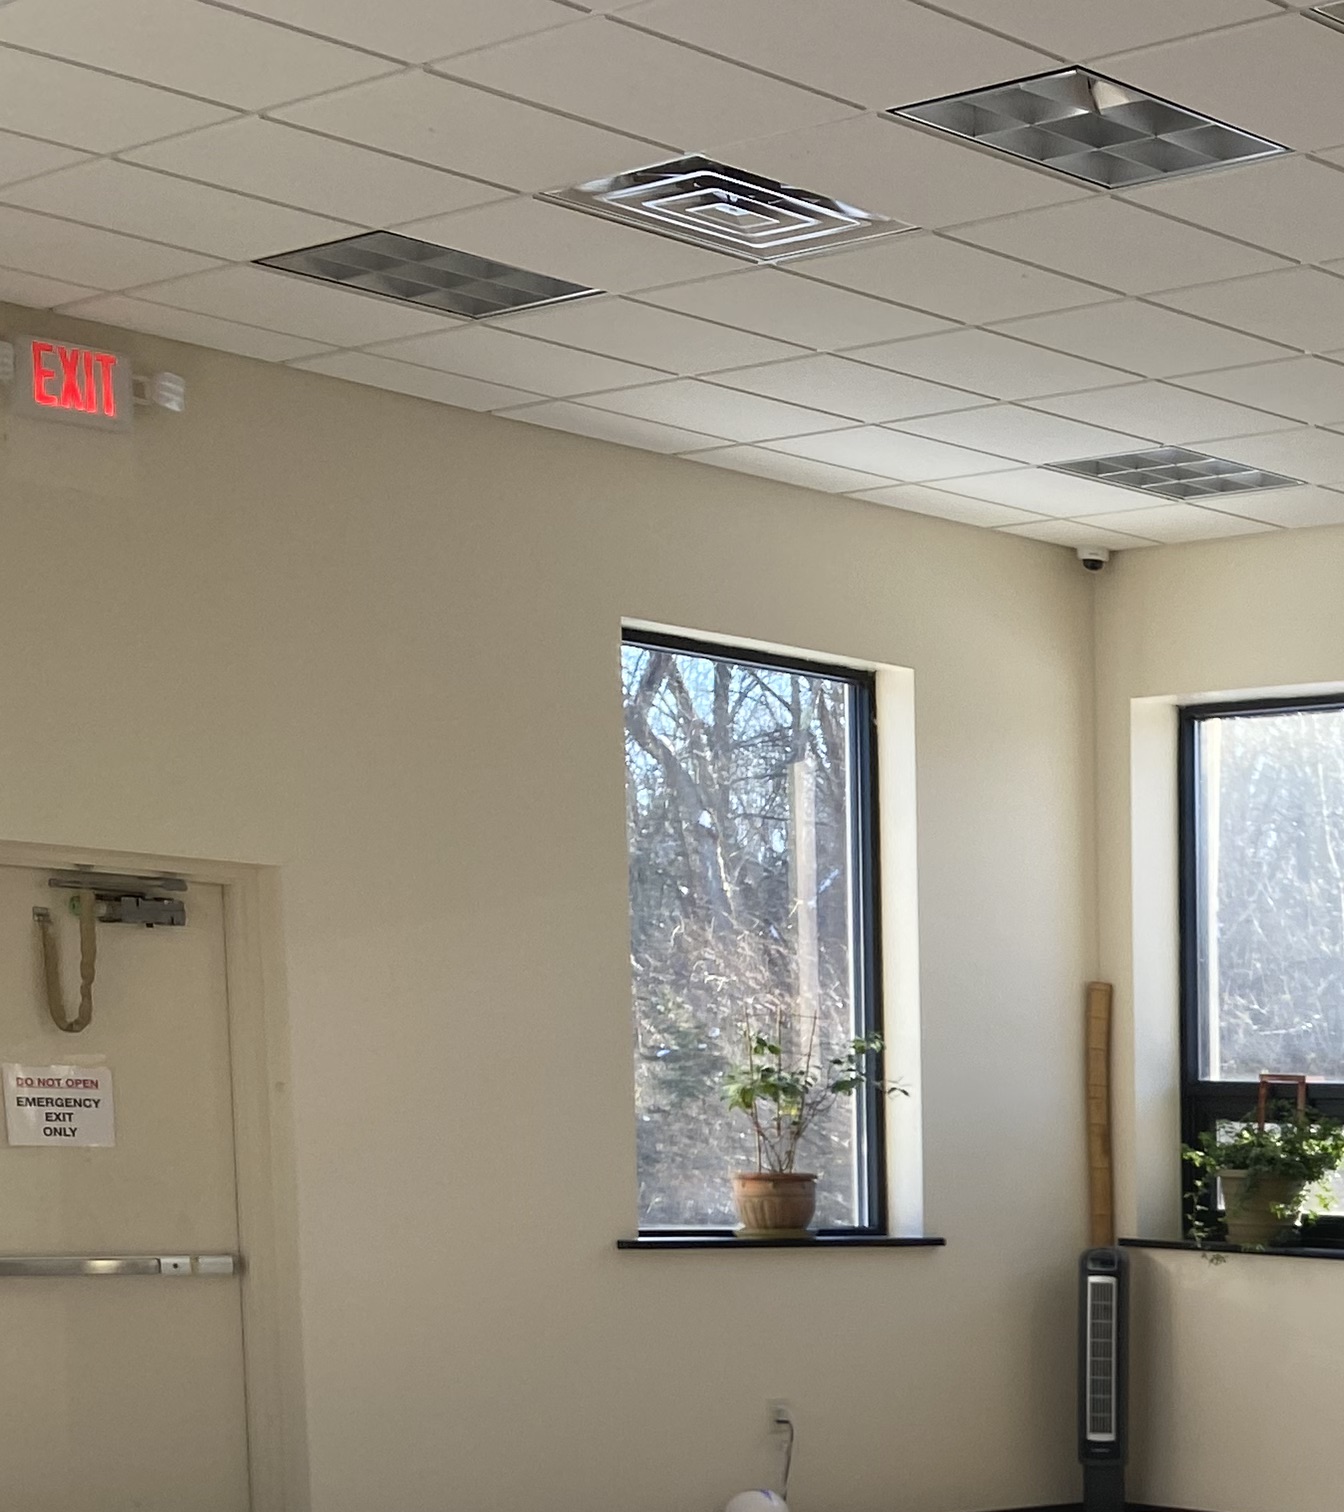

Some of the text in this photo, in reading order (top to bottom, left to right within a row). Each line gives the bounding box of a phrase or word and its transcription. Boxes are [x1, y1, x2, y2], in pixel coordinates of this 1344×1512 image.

[31, 341, 116, 417] EXIT
[16, 1077, 99, 1089] DO NOT OPEN
[16, 1097, 101, 1108] EMERGENCY
[45, 1112, 74, 1122] EXIT
[43, 1127, 77, 1137] ONLY
